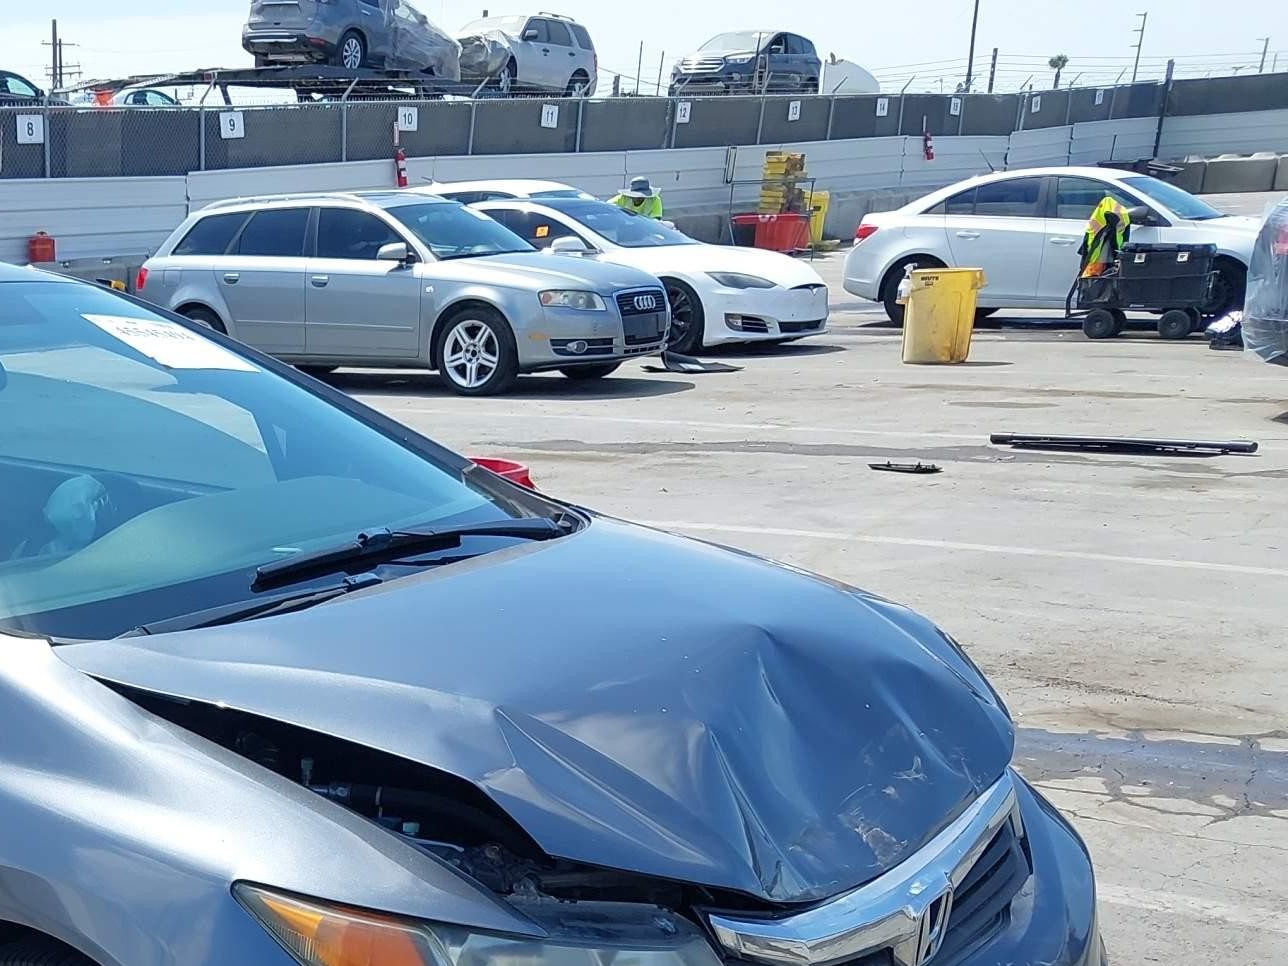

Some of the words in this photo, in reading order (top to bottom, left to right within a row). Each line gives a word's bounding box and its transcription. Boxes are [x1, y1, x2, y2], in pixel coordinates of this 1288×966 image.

[546, 110, 554, 122] 11
[679, 107, 687, 118] 12
[228, 118, 236, 131] 9
[403, 113, 413, 125] 10
[27, 122, 34, 137] 8
